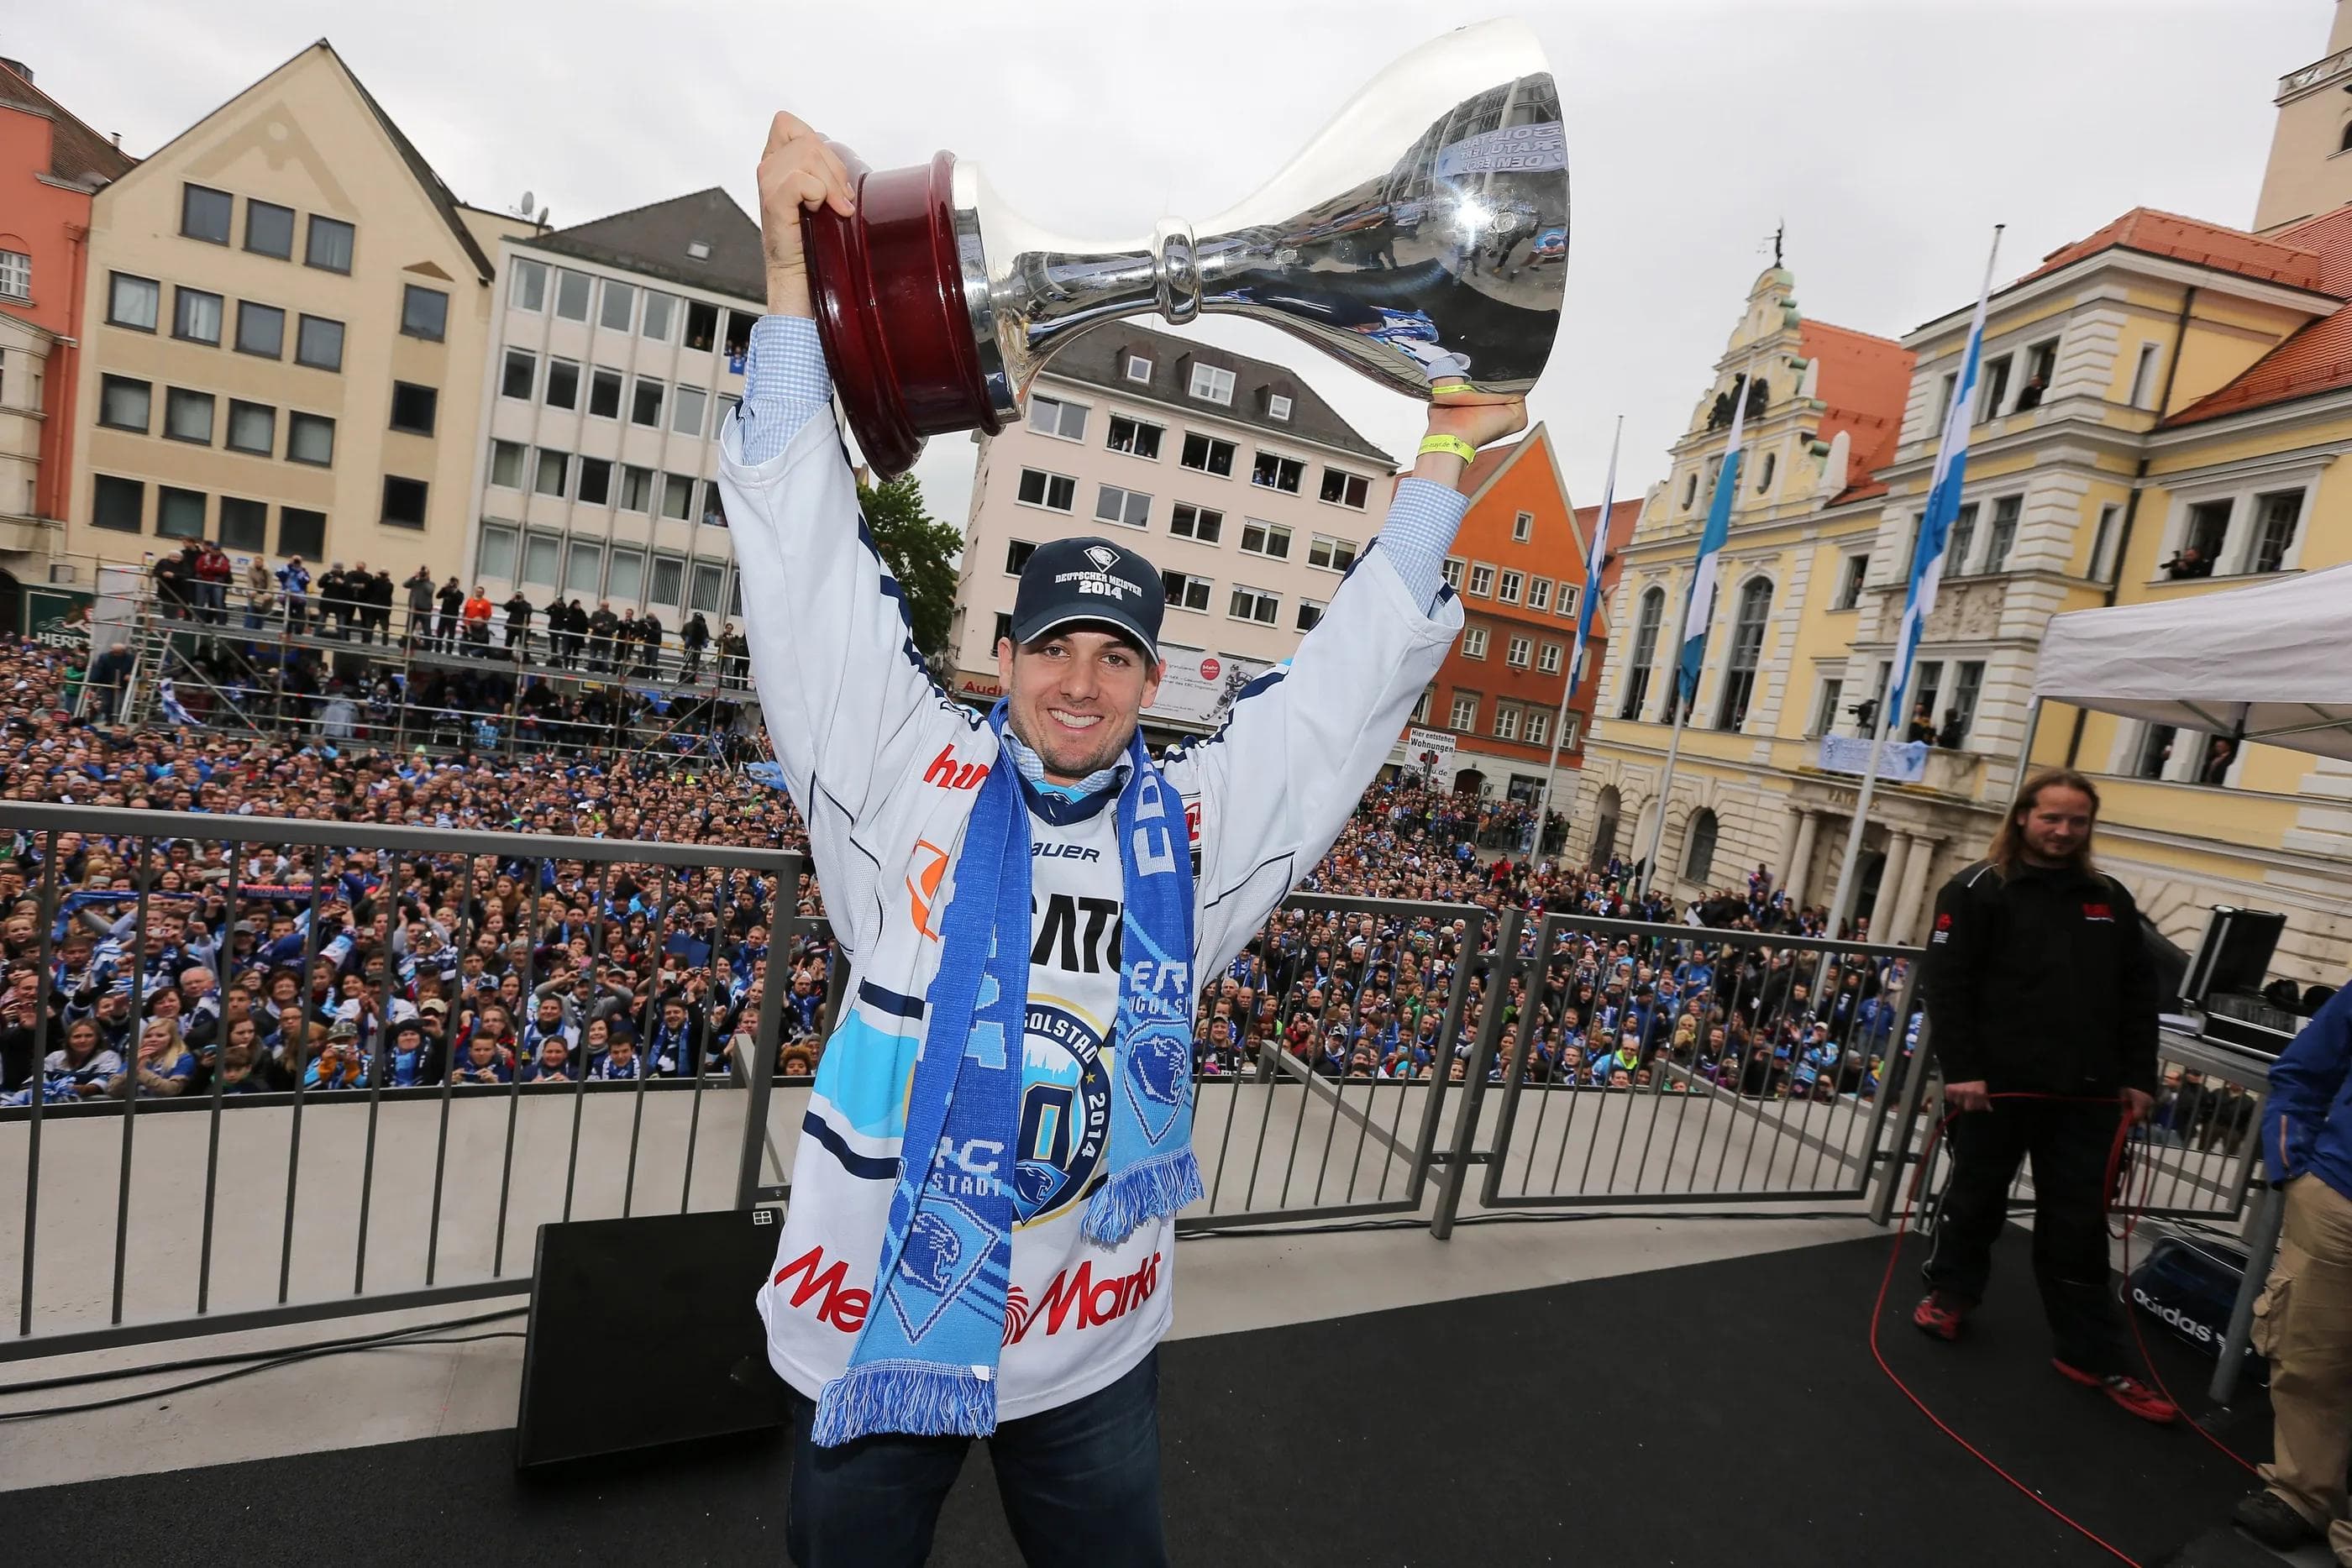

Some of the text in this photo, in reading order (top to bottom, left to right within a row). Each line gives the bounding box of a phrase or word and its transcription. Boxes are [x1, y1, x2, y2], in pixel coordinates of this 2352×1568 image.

[1054, 571, 1142, 598] DEUTSCHER MEISTER
[1078, 579, 1123, 600] 2014
[963, 680, 1002, 696] Audi
[1410, 737, 1454, 753] Wohnungen
[1411, 729, 1455, 743] Hier entstehen
[1404, 763, 1448, 777] mayru.de
[1080, 1092, 1106, 1158] 2014
[774, 1245, 1163, 1345] Me Markt
